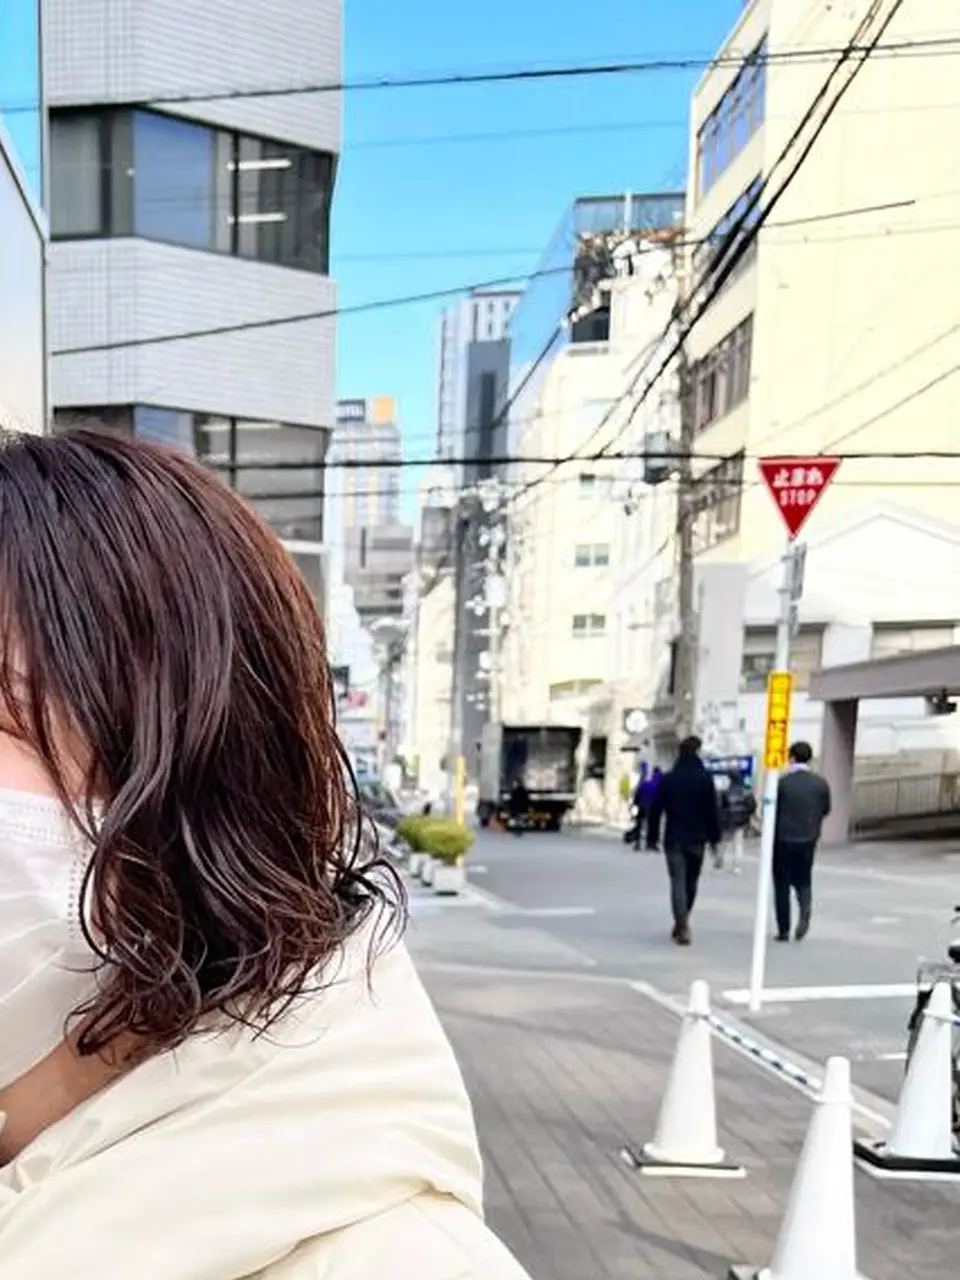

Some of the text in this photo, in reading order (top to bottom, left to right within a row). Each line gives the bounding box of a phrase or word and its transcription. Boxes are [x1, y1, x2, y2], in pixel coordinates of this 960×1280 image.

[772, 467, 824, 488] 止まれ
[779, 489, 817, 506] STOP
